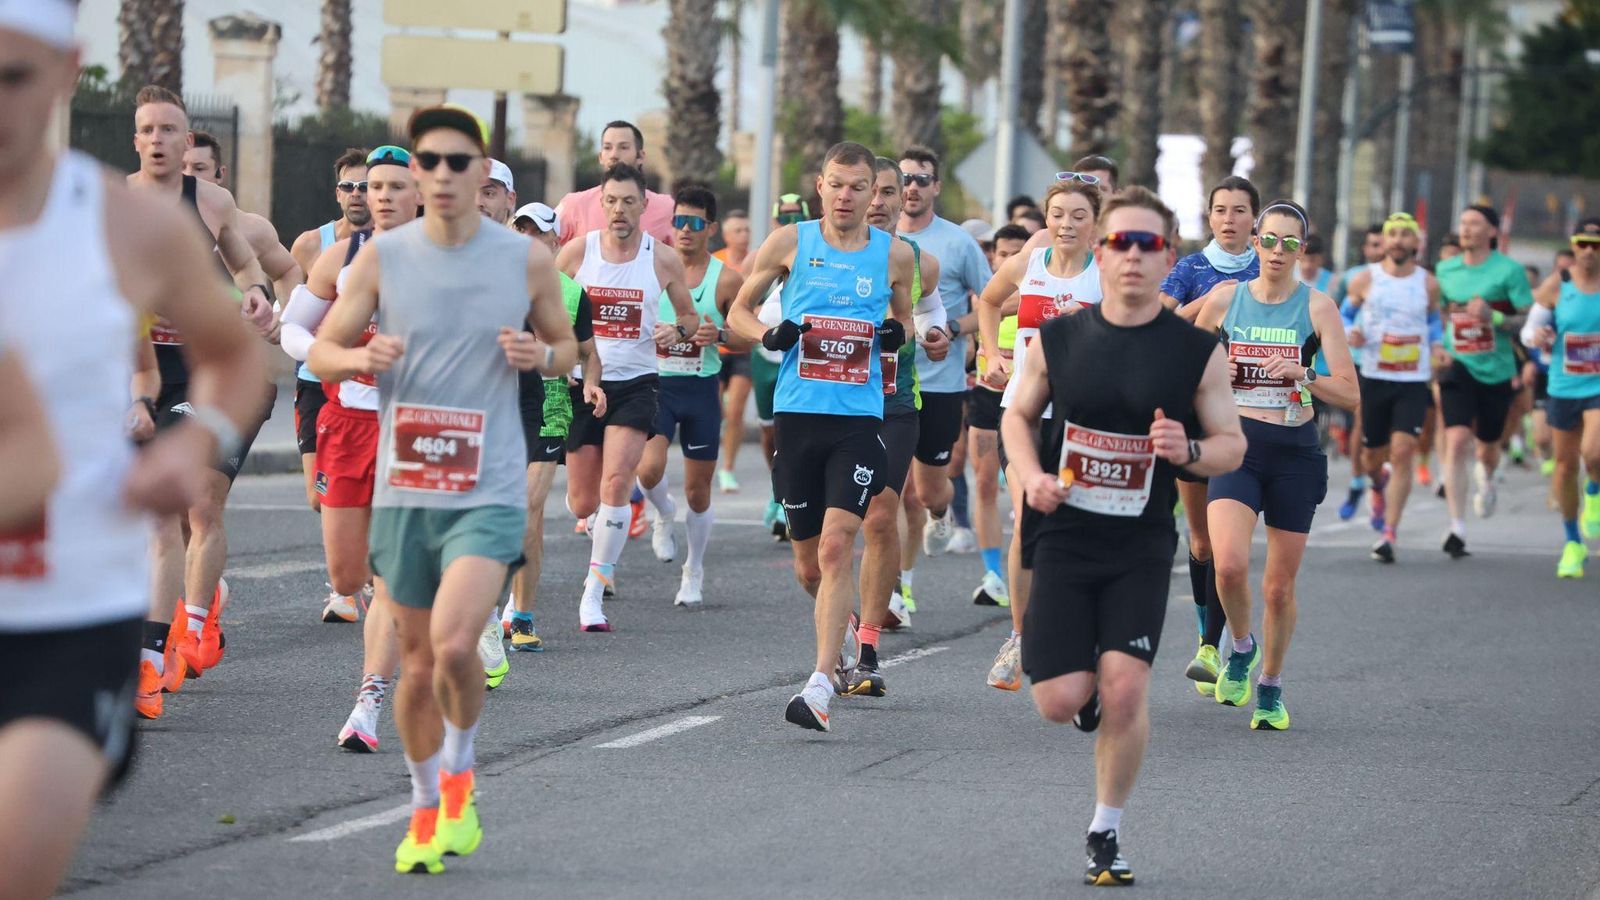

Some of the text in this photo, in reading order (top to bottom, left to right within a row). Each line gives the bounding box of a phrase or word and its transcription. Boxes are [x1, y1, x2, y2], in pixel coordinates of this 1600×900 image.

[601, 289, 640, 299] GENERALI
[600, 305, 628, 317] 2752
[822, 320, 869, 333] GENERALI
[1251, 327, 1296, 344] PUMA
[668, 342, 693, 353] 392
[820, 340, 855, 354] 5760
[1247, 346, 1294, 357] GENERALI
[1243, 366, 1284, 379] 170
[415, 409, 478, 427] GENERALI
[412, 436, 457, 456] 4604
[1088, 433, 1148, 451] GENERALI
[1080, 457, 1132, 480] 13921
